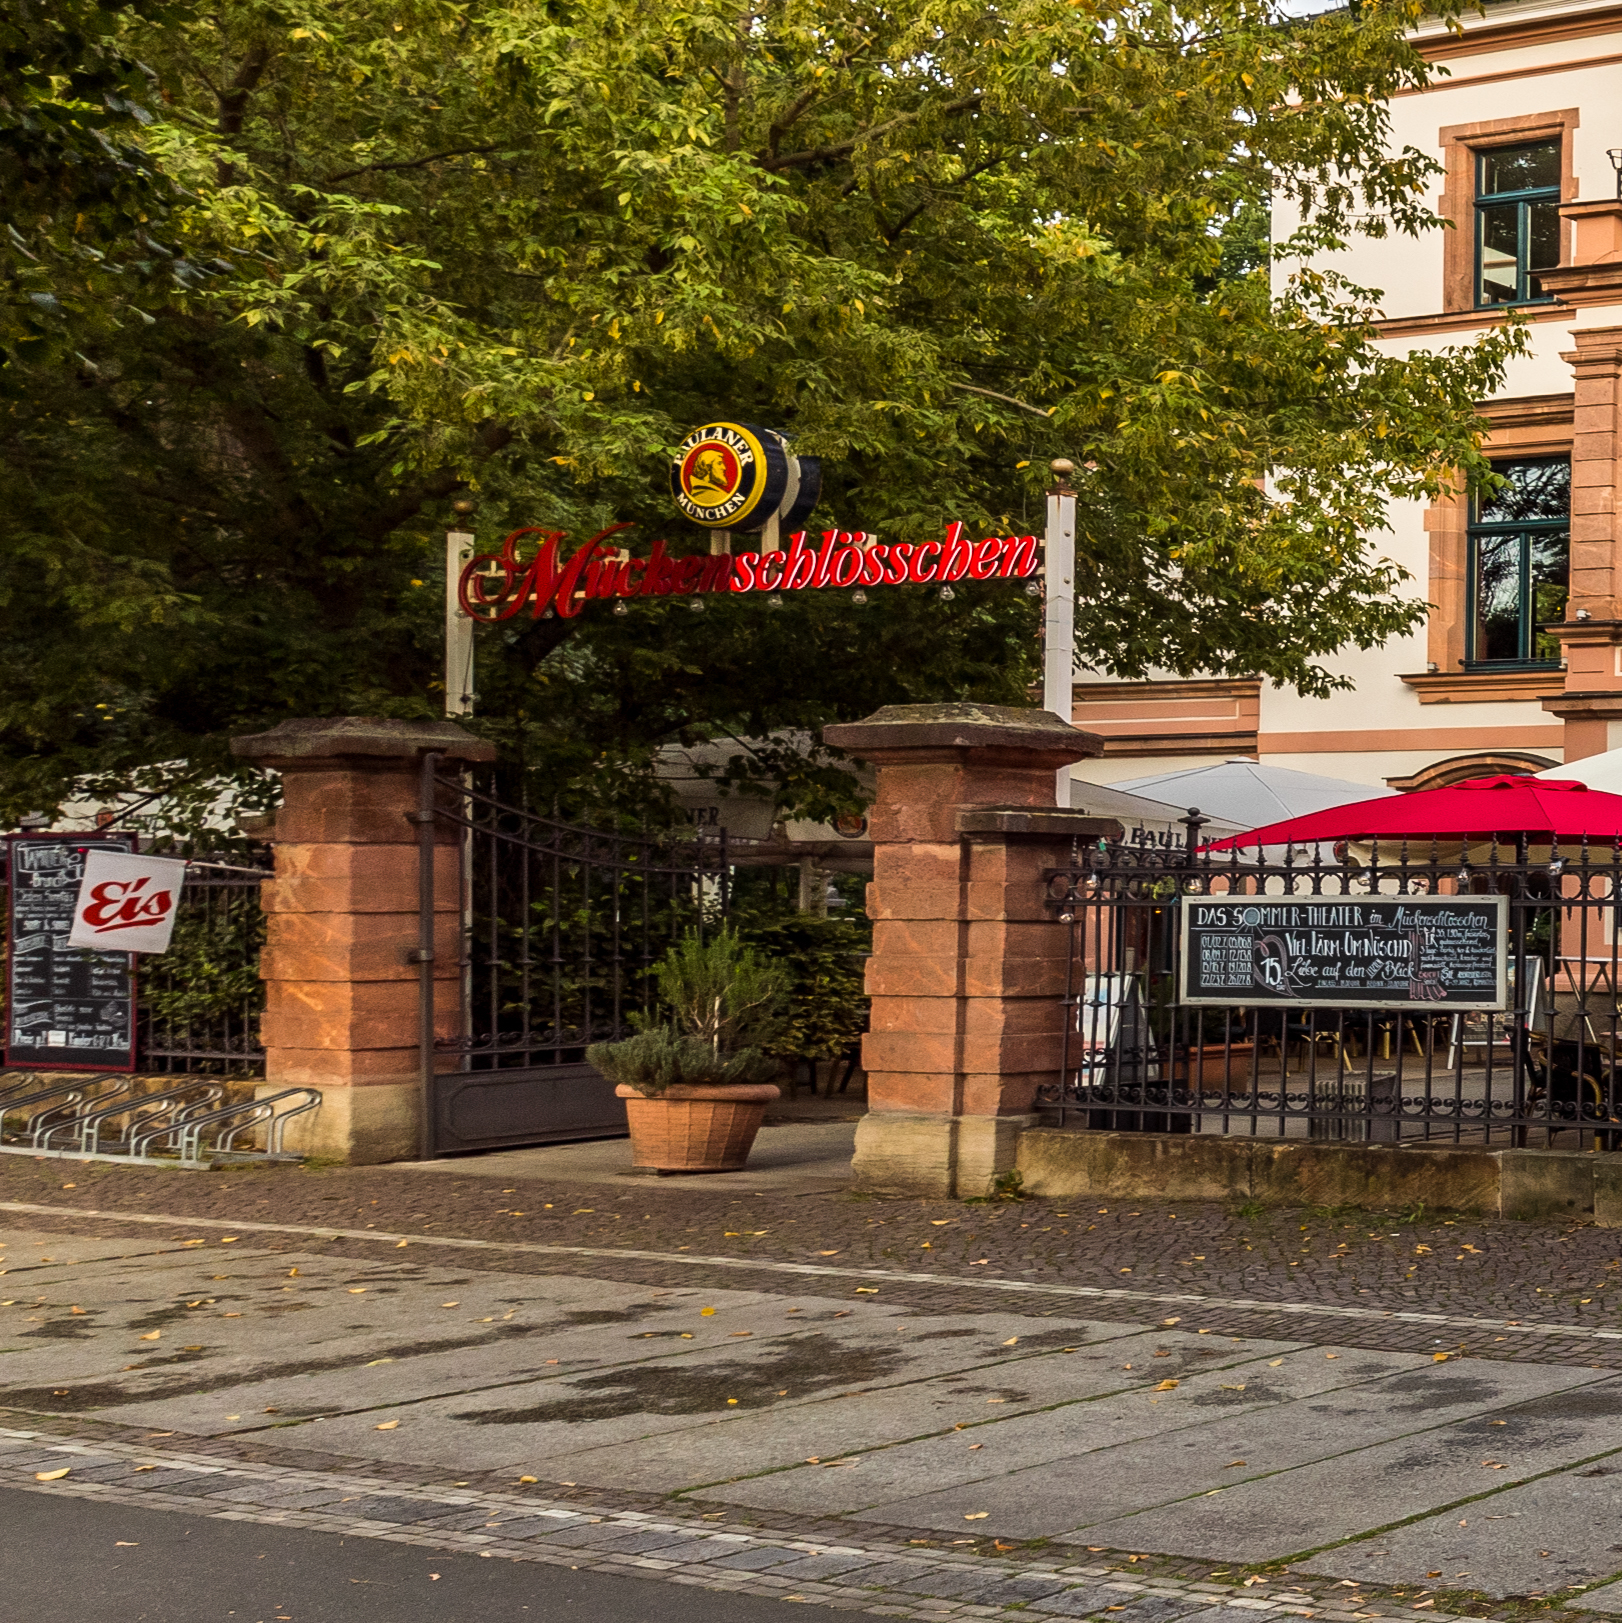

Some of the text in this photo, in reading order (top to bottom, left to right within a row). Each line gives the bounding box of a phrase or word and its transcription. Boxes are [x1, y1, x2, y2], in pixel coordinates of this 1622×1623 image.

[458, 521, 1039, 622] Mückenschlösschen
[82, 876, 172, 927] Eis
[1197, 907, 1227, 925] DAS
[1232, 906, 1363, 926] SOMMER-THEATER
[1369, 909, 1384, 924] im
[1322, 962, 1342, 980] auf
[1345, 961, 1366, 978] den
[1381, 960, 1422, 982] Blick
